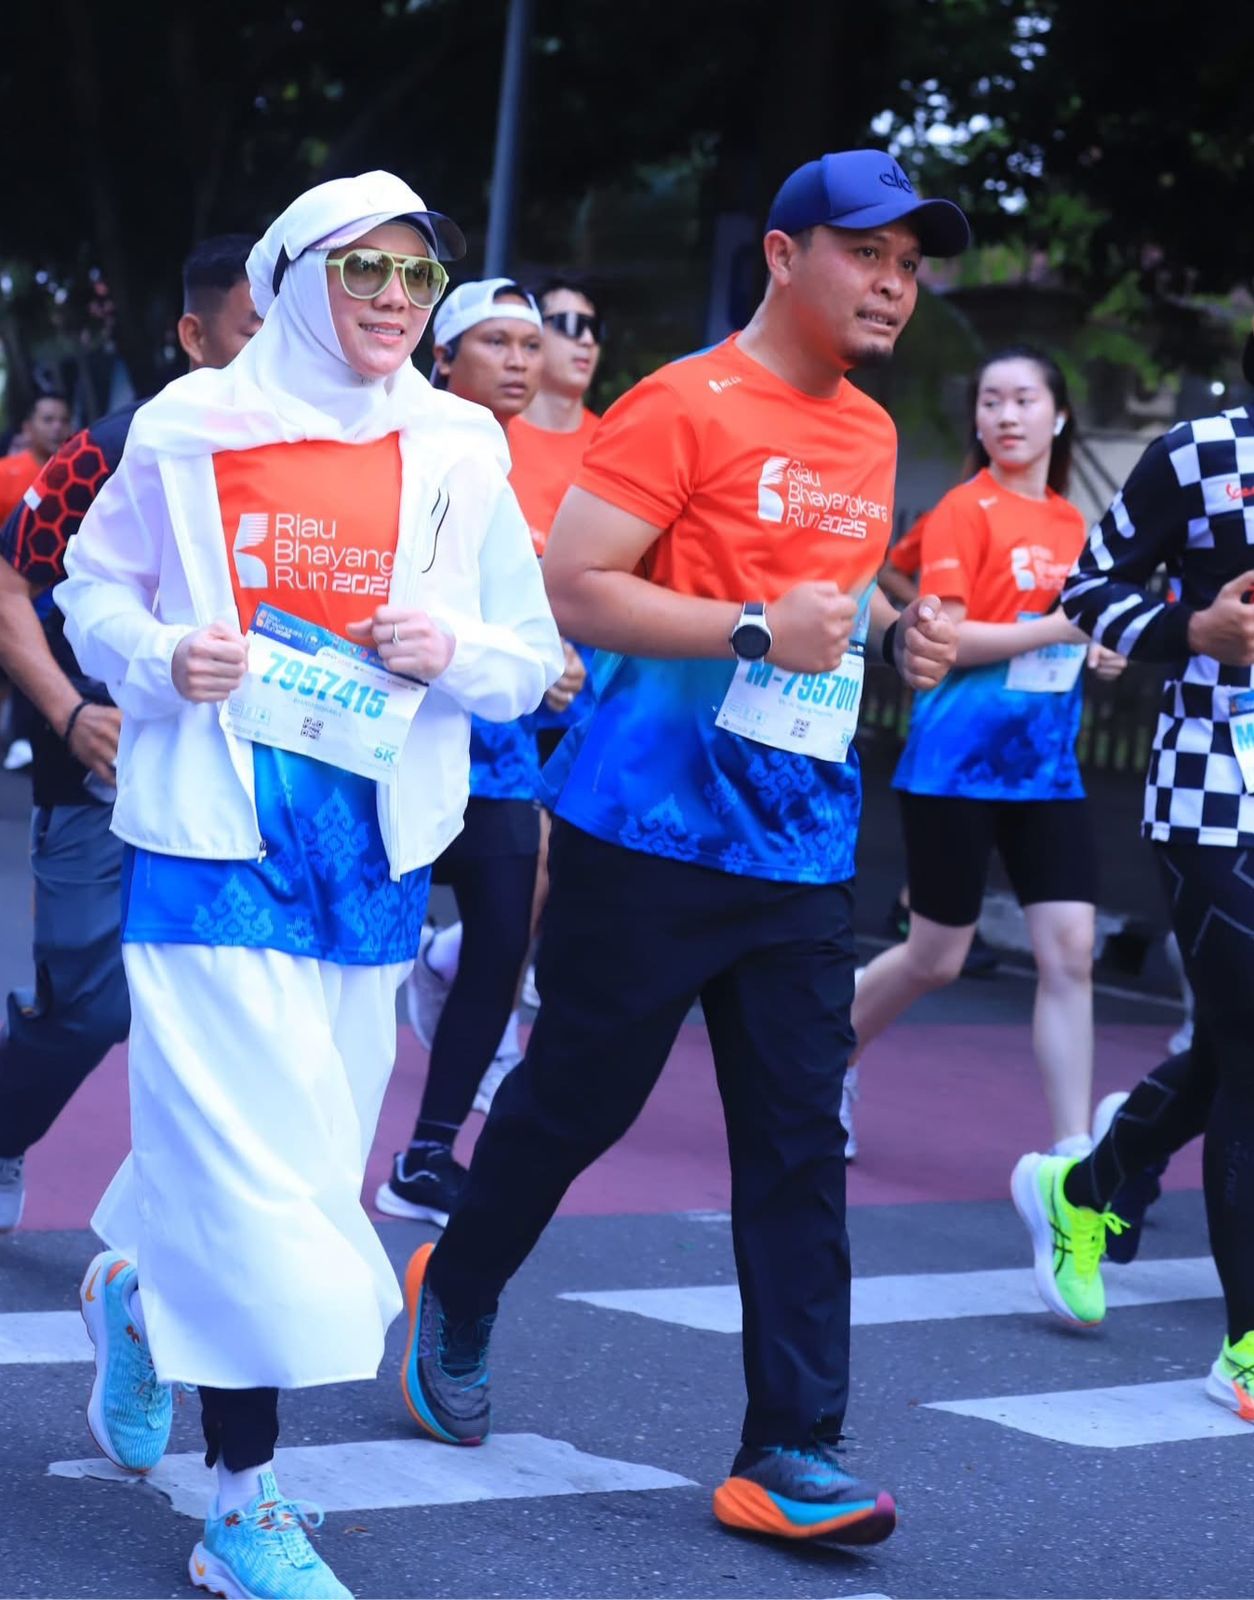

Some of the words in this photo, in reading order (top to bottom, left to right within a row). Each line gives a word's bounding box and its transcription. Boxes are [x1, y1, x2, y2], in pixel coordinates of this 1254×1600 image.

[787, 459, 821, 487] Riau
[787, 481, 888, 522] Bhayangkara
[275, 513, 336, 540] Riau
[786, 505, 820, 528] Run
[818, 514, 867, 539] 2025
[275, 566, 328, 590] Run
[260, 651, 389, 720] 7957415
[374, 746, 396, 764] 5K
